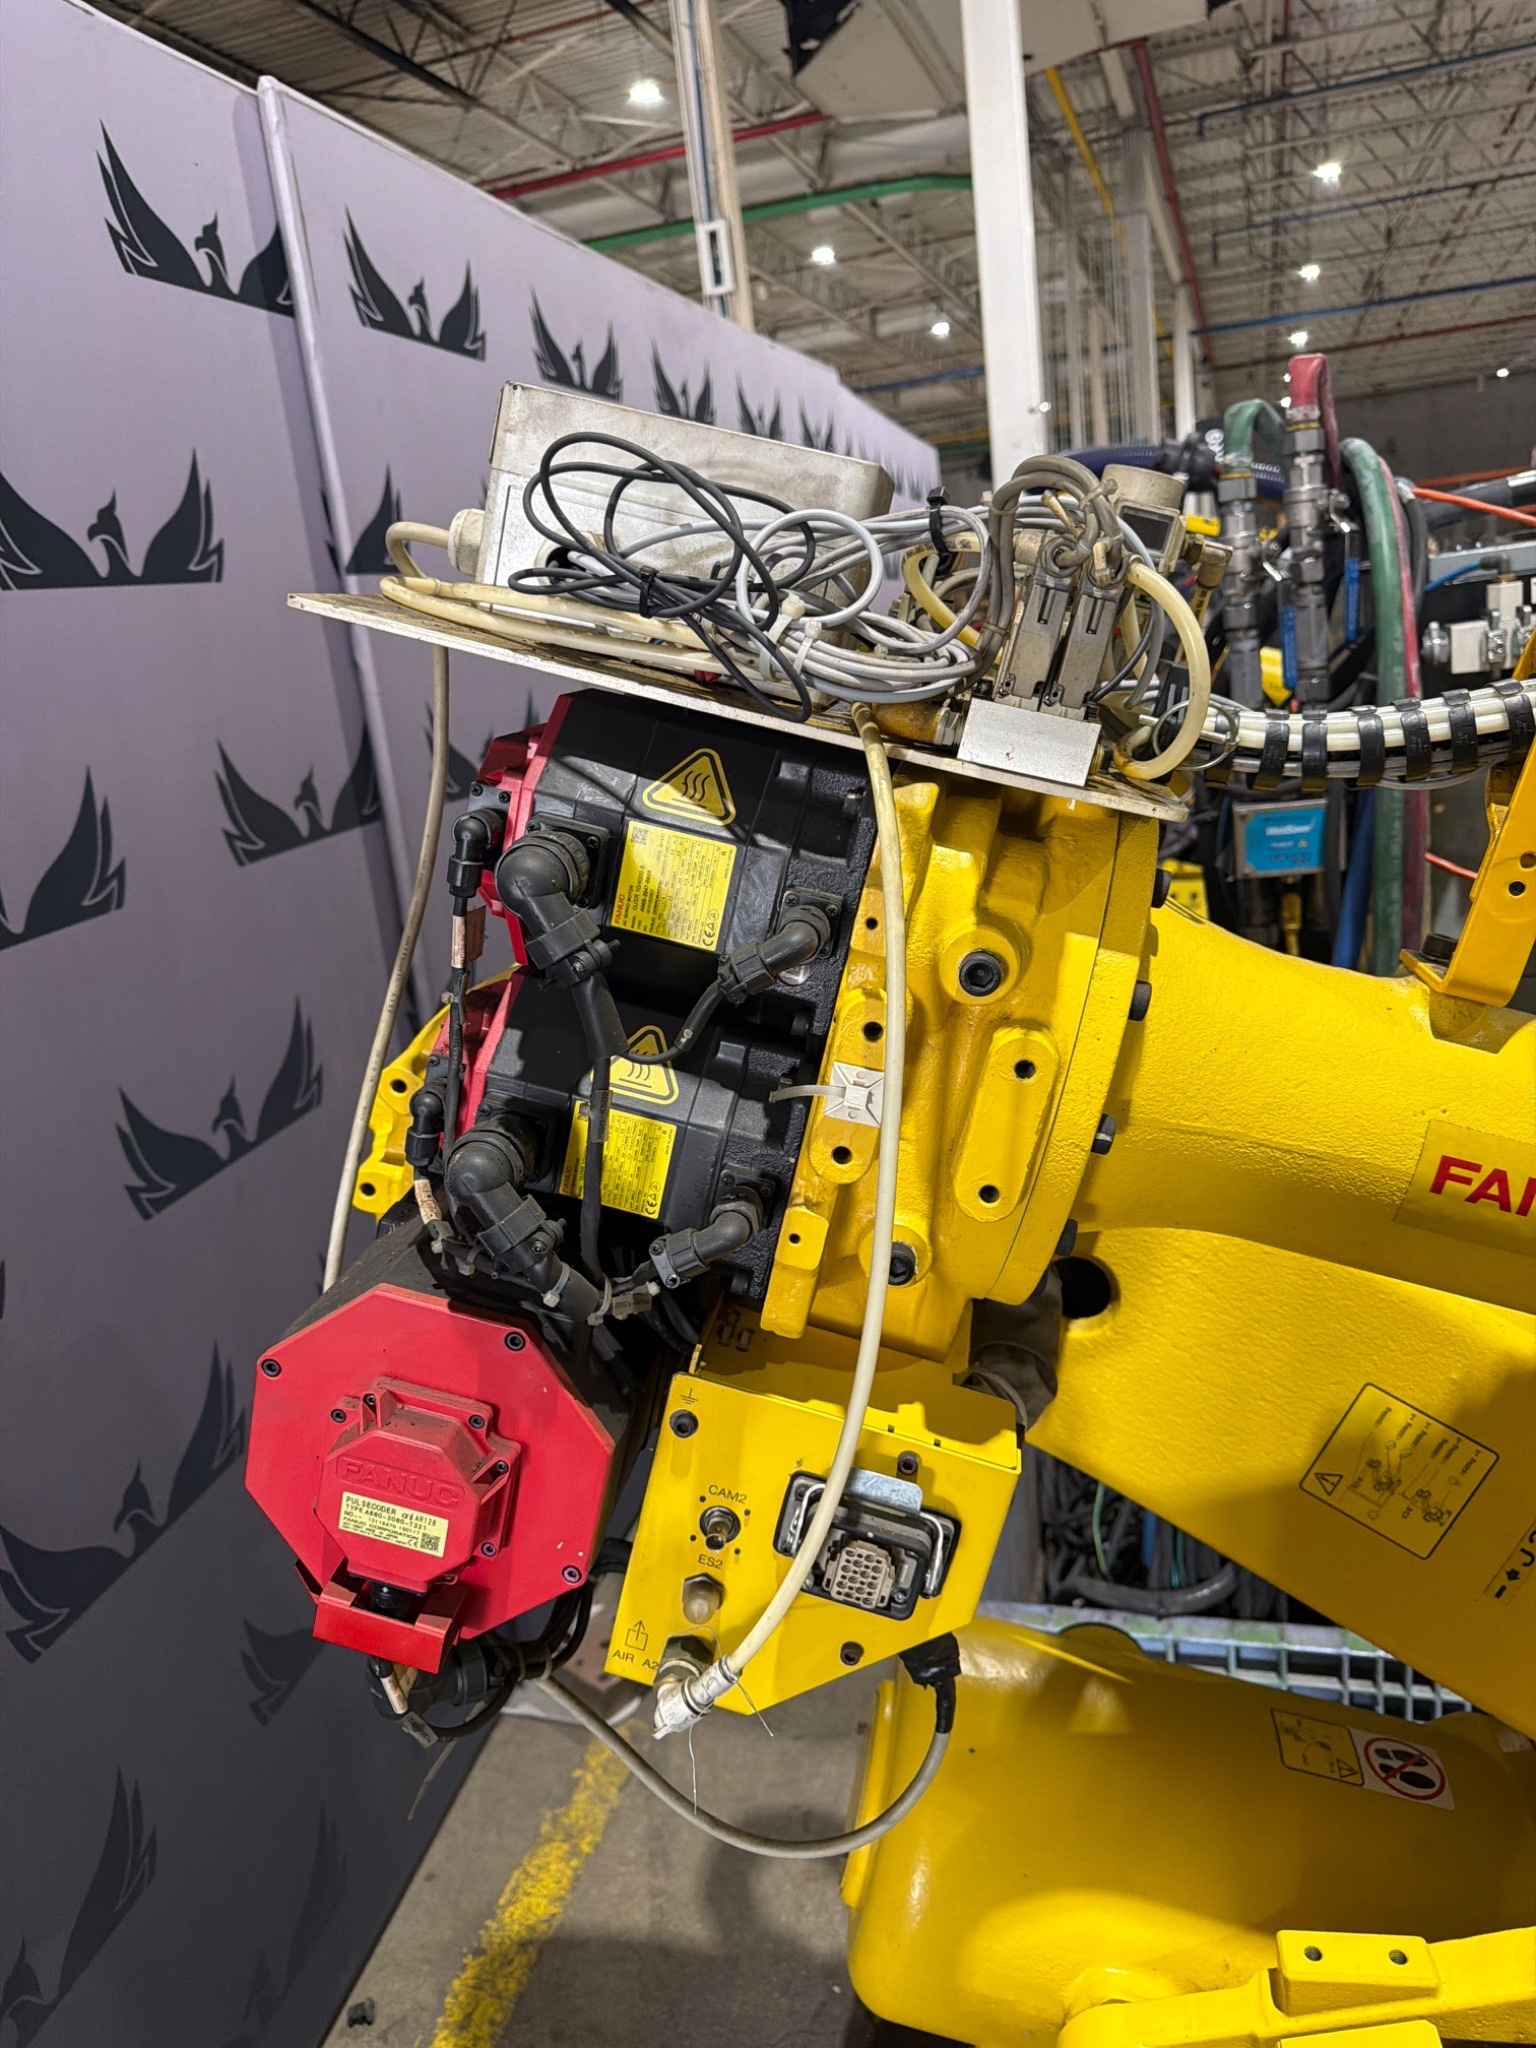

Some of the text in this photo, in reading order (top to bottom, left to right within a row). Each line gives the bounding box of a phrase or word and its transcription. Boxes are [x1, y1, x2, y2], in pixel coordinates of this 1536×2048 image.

[614, 893, 625, 924] FANUC
[562, 1164, 572, 1193] FANUC
[340, 1457, 460, 1507] FANUC
[345, 1495, 396, 1515] PULSECODER
[708, 1484, 748, 1504] CAM2
[345, 1503, 363, 1513] TYPE
[343, 1516, 366, 1526] FANUC
[368, 1523, 419, 1540] CORPORATION
[697, 1553, 724, 1570] ES2
[612, 1648, 659, 1671] AIR A2
